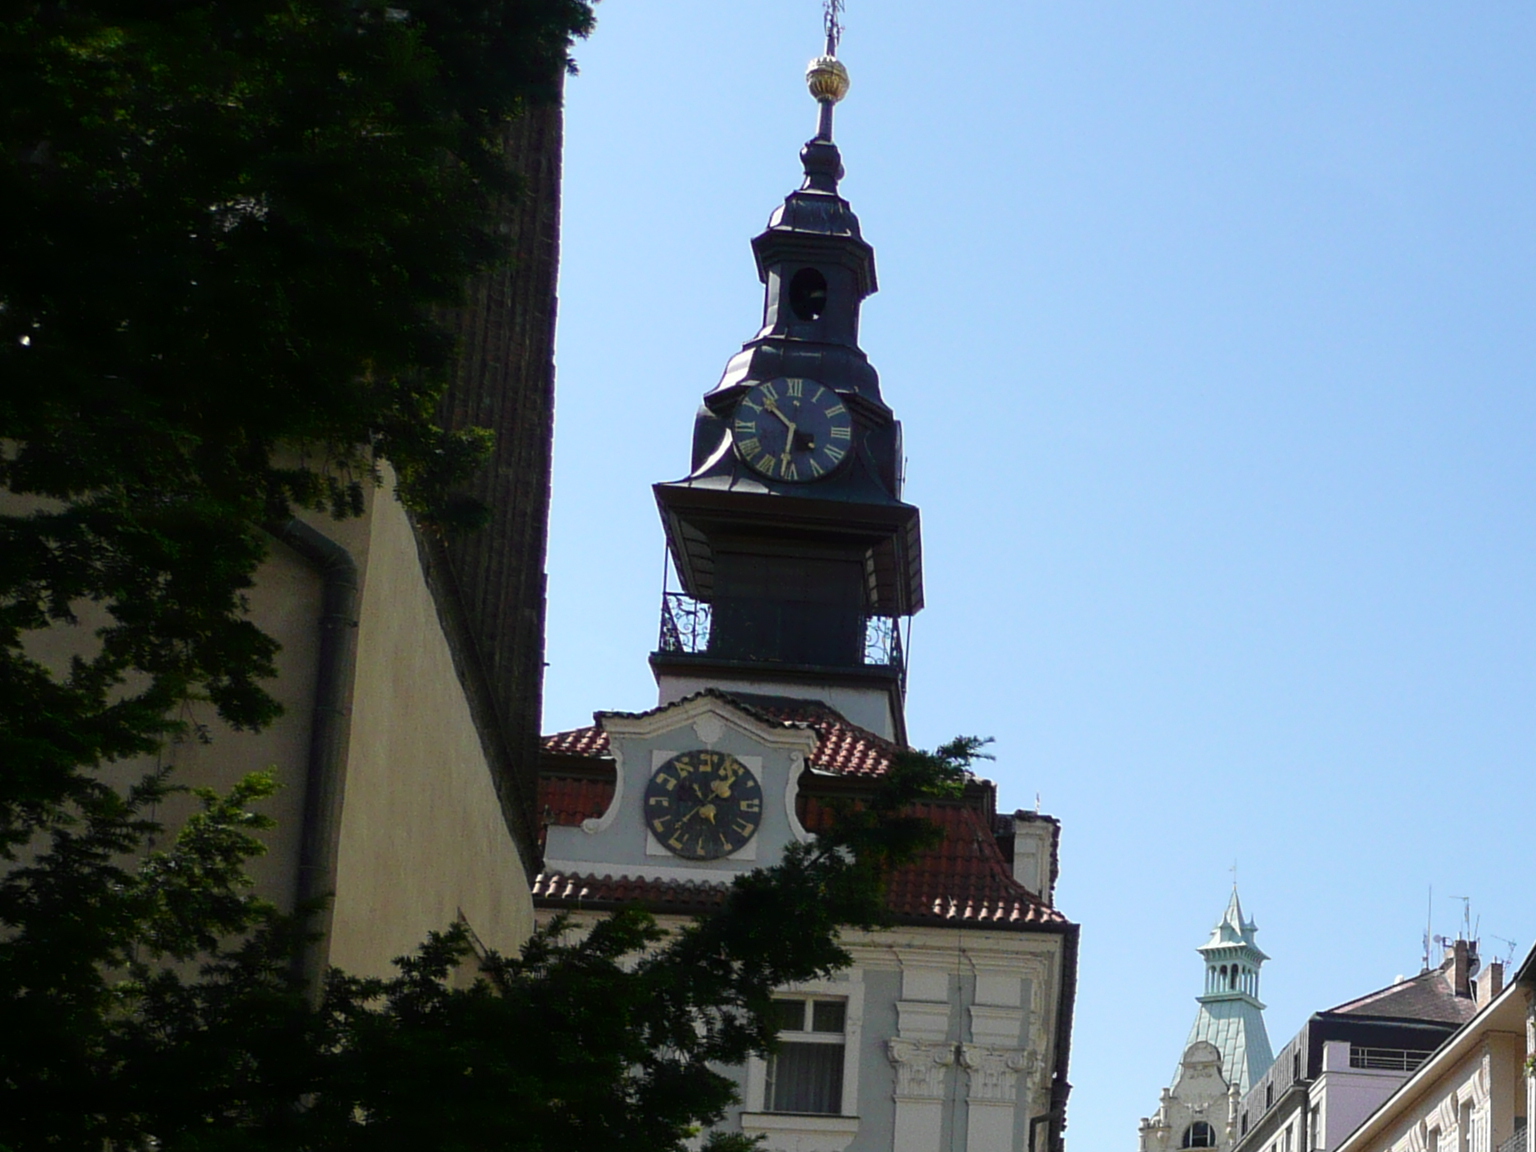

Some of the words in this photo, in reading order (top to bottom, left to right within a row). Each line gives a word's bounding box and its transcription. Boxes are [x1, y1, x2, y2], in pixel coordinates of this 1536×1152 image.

[787, 378, 803, 397] XII
[811, 387, 825, 403] I
[742, 397, 763, 414] X
[825, 404, 846, 419] II
[734, 420, 756, 433] IX
[830, 427, 851, 440] III
[756, 454, 776, 475] VII
[809, 458, 825, 477] V
